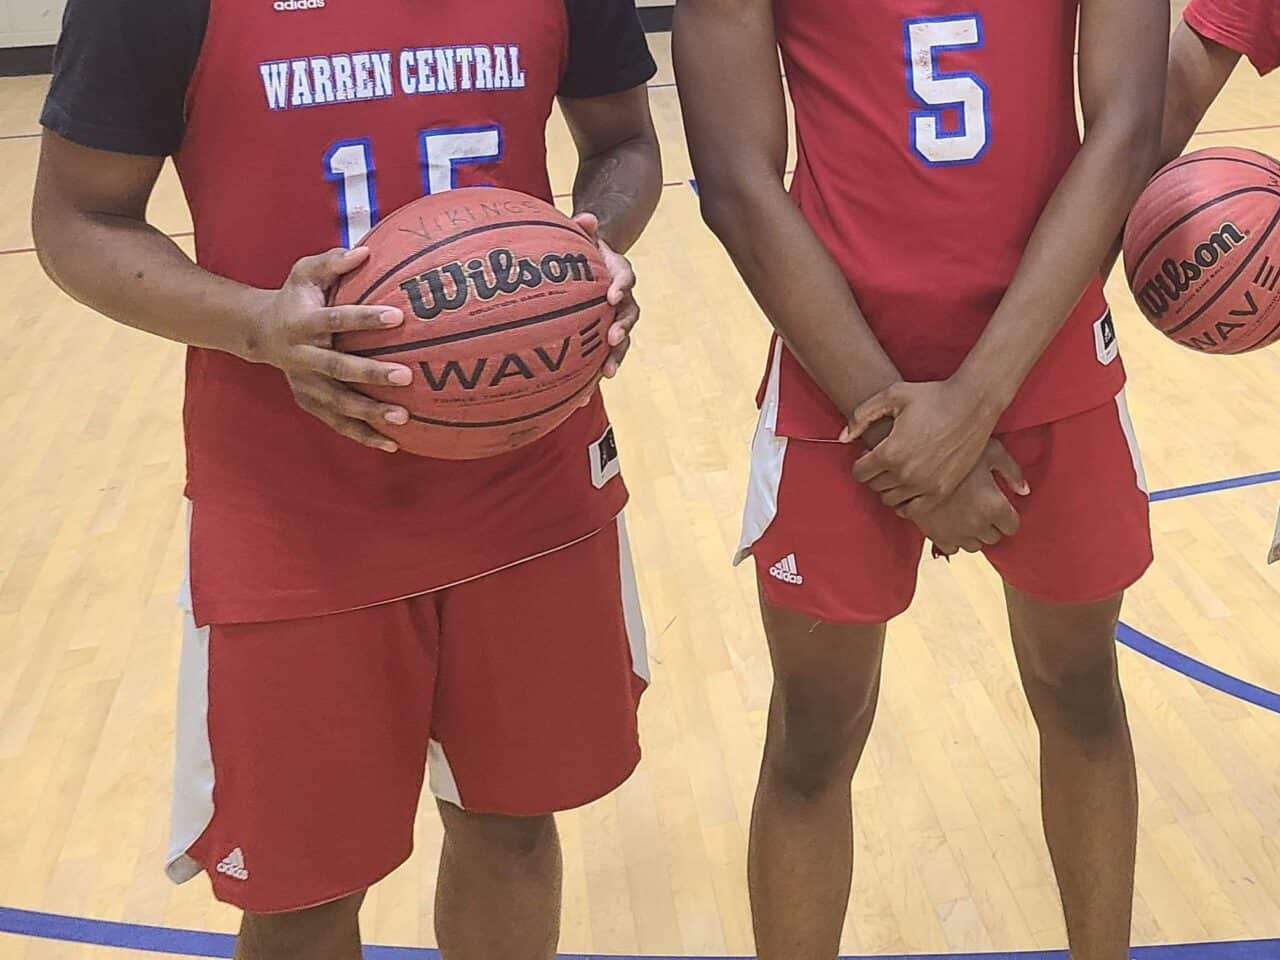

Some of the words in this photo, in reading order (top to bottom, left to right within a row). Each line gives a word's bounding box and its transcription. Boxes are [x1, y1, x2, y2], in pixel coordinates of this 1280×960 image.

[259, 50, 394, 111] WARREN
[398, 42, 526, 95] CENTRAL
[904, 13, 991, 167] 5
[398, 200, 542, 240] VIKINGS
[400, 248, 594, 320] Wilson
[1136, 222, 1246, 321] Wilson
[418, 319, 602, 391] WAVE
[769, 566, 803, 585] adidas
